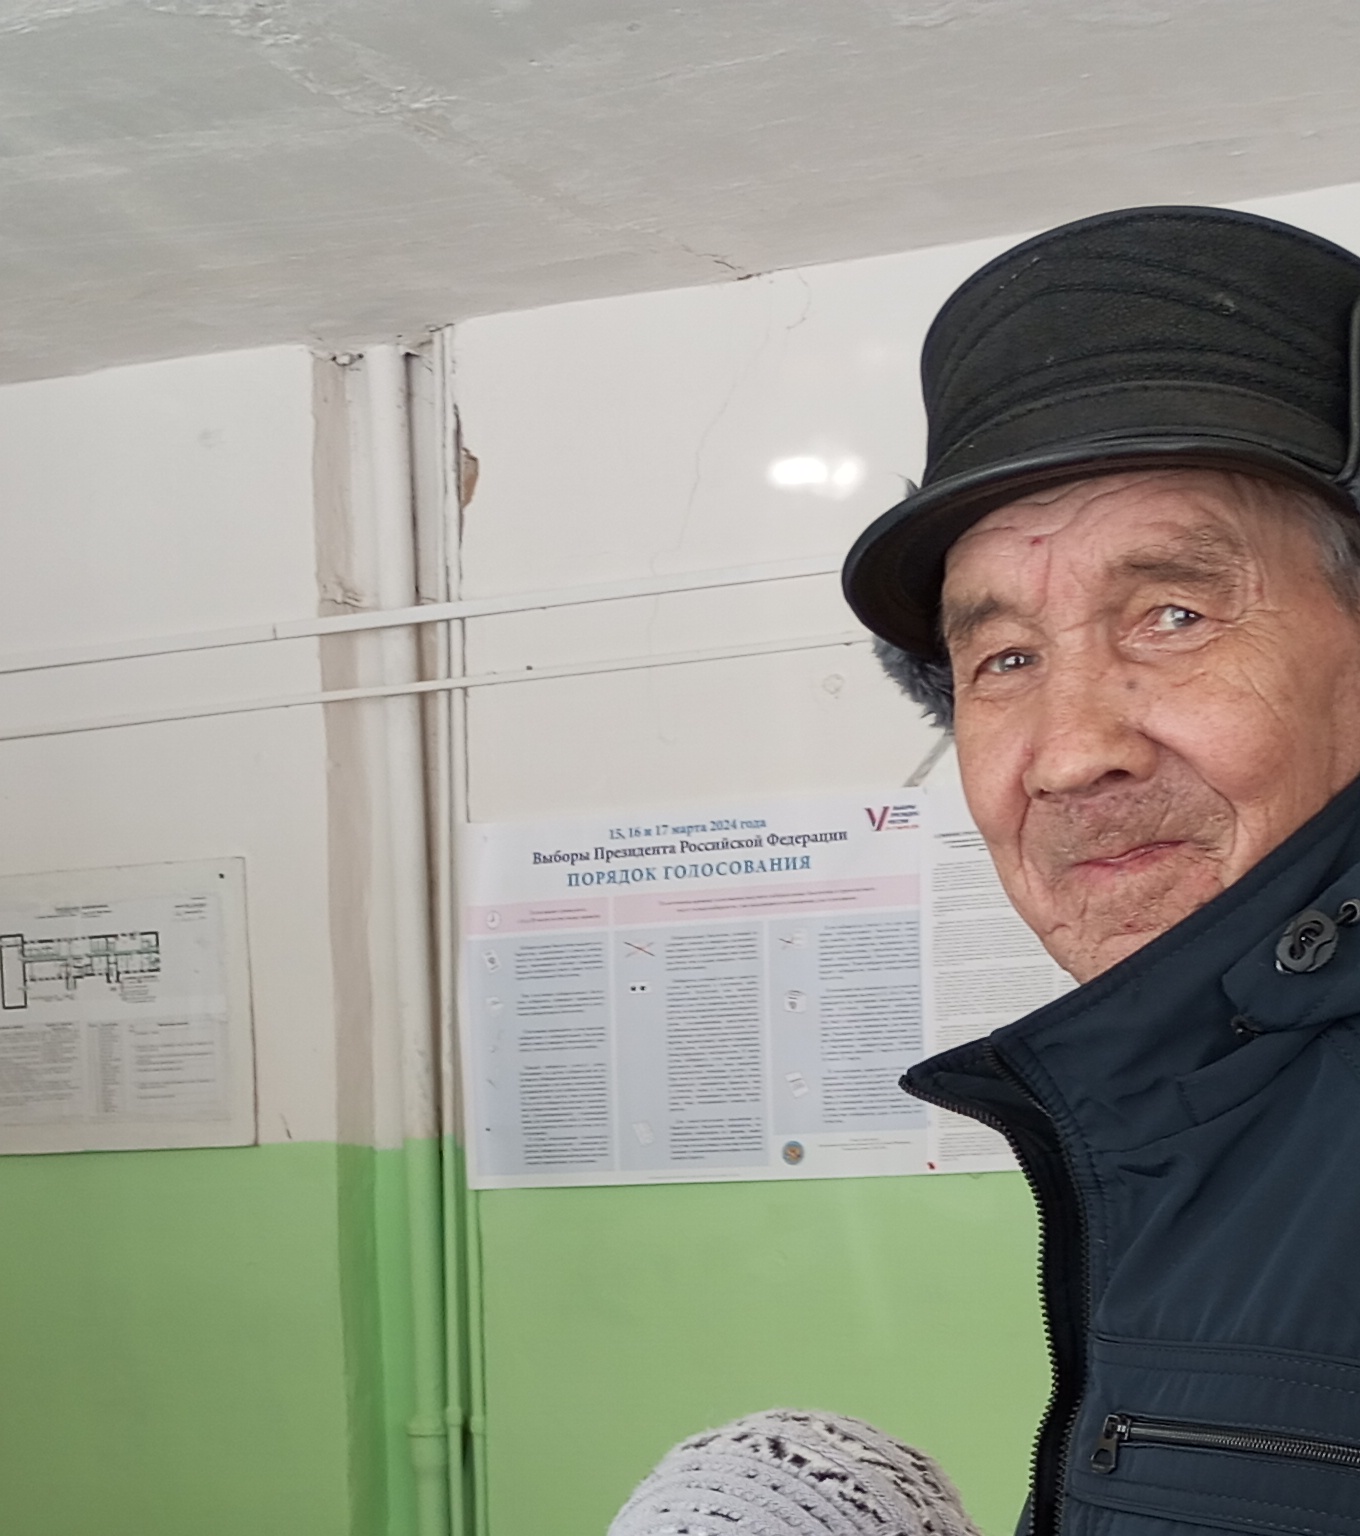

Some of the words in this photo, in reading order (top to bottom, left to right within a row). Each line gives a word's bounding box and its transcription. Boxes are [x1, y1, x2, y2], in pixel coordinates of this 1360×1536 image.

[609, 828, 625, 841] 15,
[628, 826, 642, 838] 16
[645, 828, 653, 837] и
[655, 824, 668, 836] 17
[671, 823, 707, 838] марта
[710, 819, 737, 832] 2024
[740, 818, 766, 831] года
[532, 848, 590, 865] Выборы
[593, 842, 676, 862] Президента
[680, 834, 762, 854] Российской
[766, 829, 848, 847] Федерации
[567, 867, 657, 887] ПОРЯДОК
[663, 855, 812, 881] ГОЛОСОВАНИЯ
